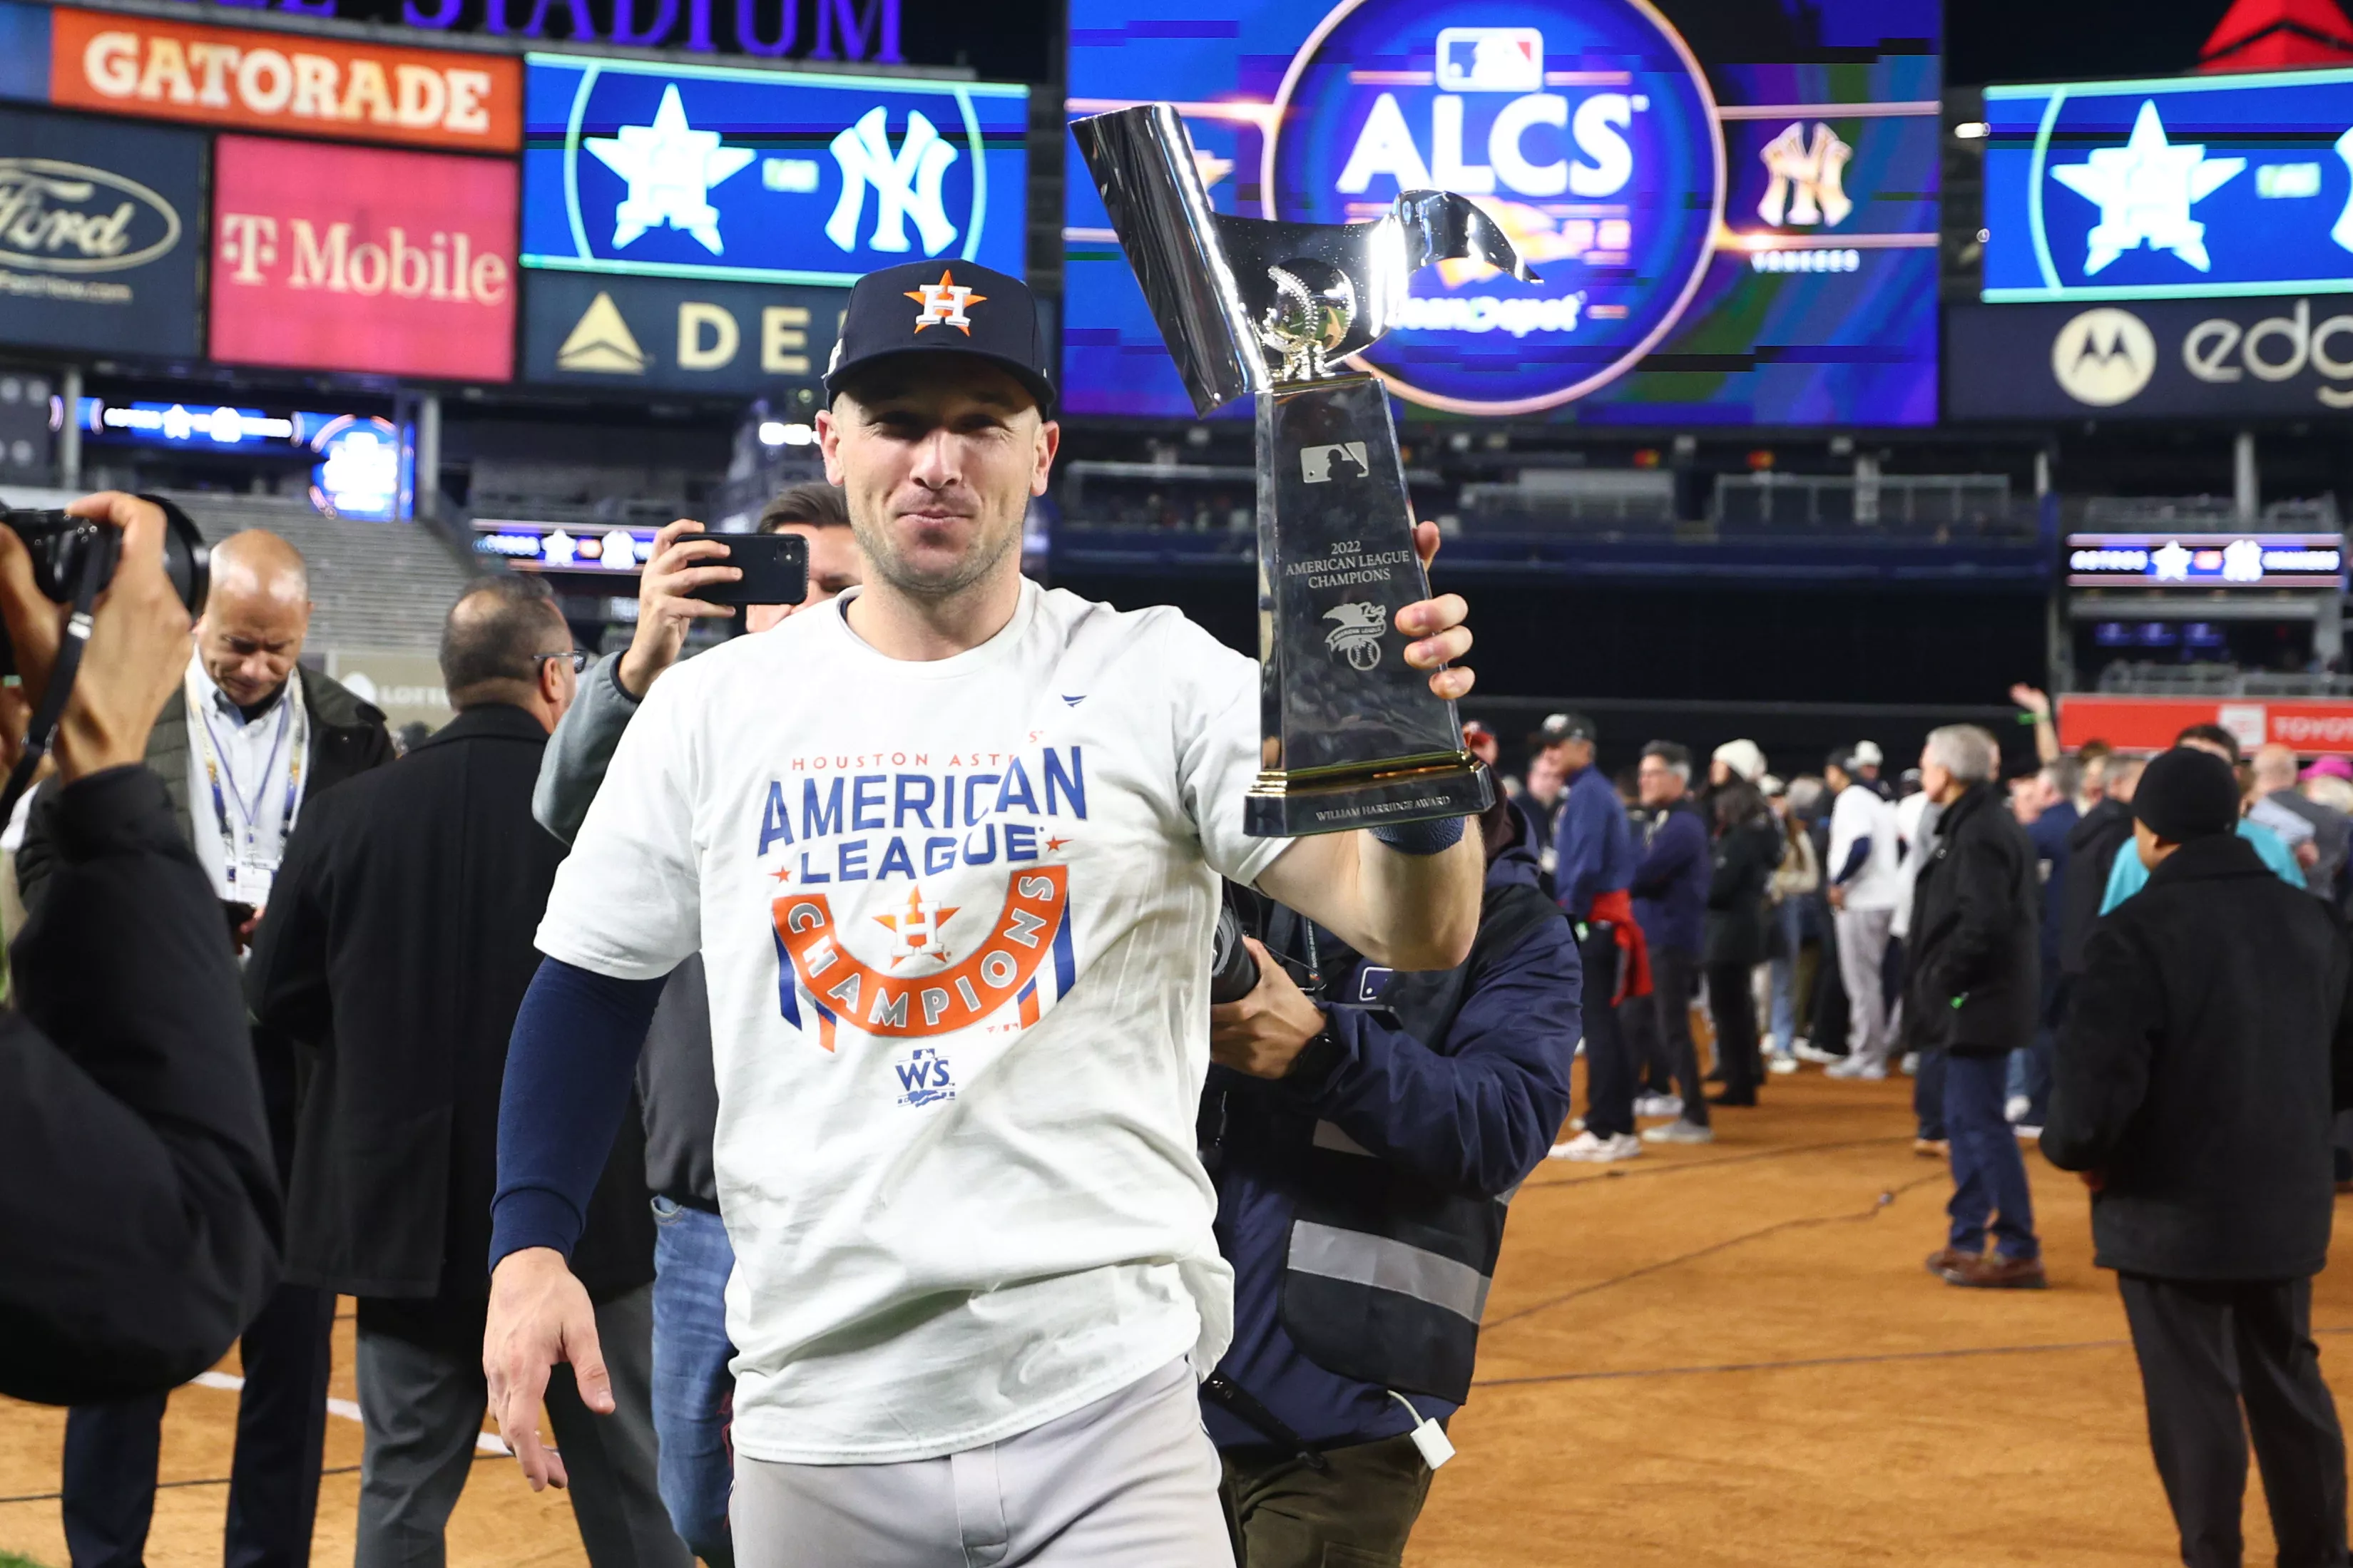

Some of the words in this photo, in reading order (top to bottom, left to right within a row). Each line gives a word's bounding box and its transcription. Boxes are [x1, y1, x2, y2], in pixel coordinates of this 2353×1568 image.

[402, 0, 907, 64] DIUM
[82, 30, 492, 134] GATORADE
[1335, 93, 1633, 198] ALCS
[288, 217, 509, 305] Mobile
[915, 284, 973, 327] H
[677, 302, 847, 374] DE
[1285, 557, 1356, 575] AMERICAN
[1358, 550, 1410, 568] LEAGUE
[1308, 568, 1391, 588] CHAMPIONS
[1331, 540, 1361, 555] 2022
[792, 752, 928, 772] HOUSTON
[757, 745, 1088, 857] AMERICAN
[1315, 806, 1360, 821] WILLIAM
[1362, 799, 1414, 816] HARRIDGE
[1414, 795, 1451, 809] AWARD
[800, 823, 1040, 885] LEAGUE
[787, 875, 1056, 1028] CHAMPIONS
[894, 1059, 950, 1092] WS
